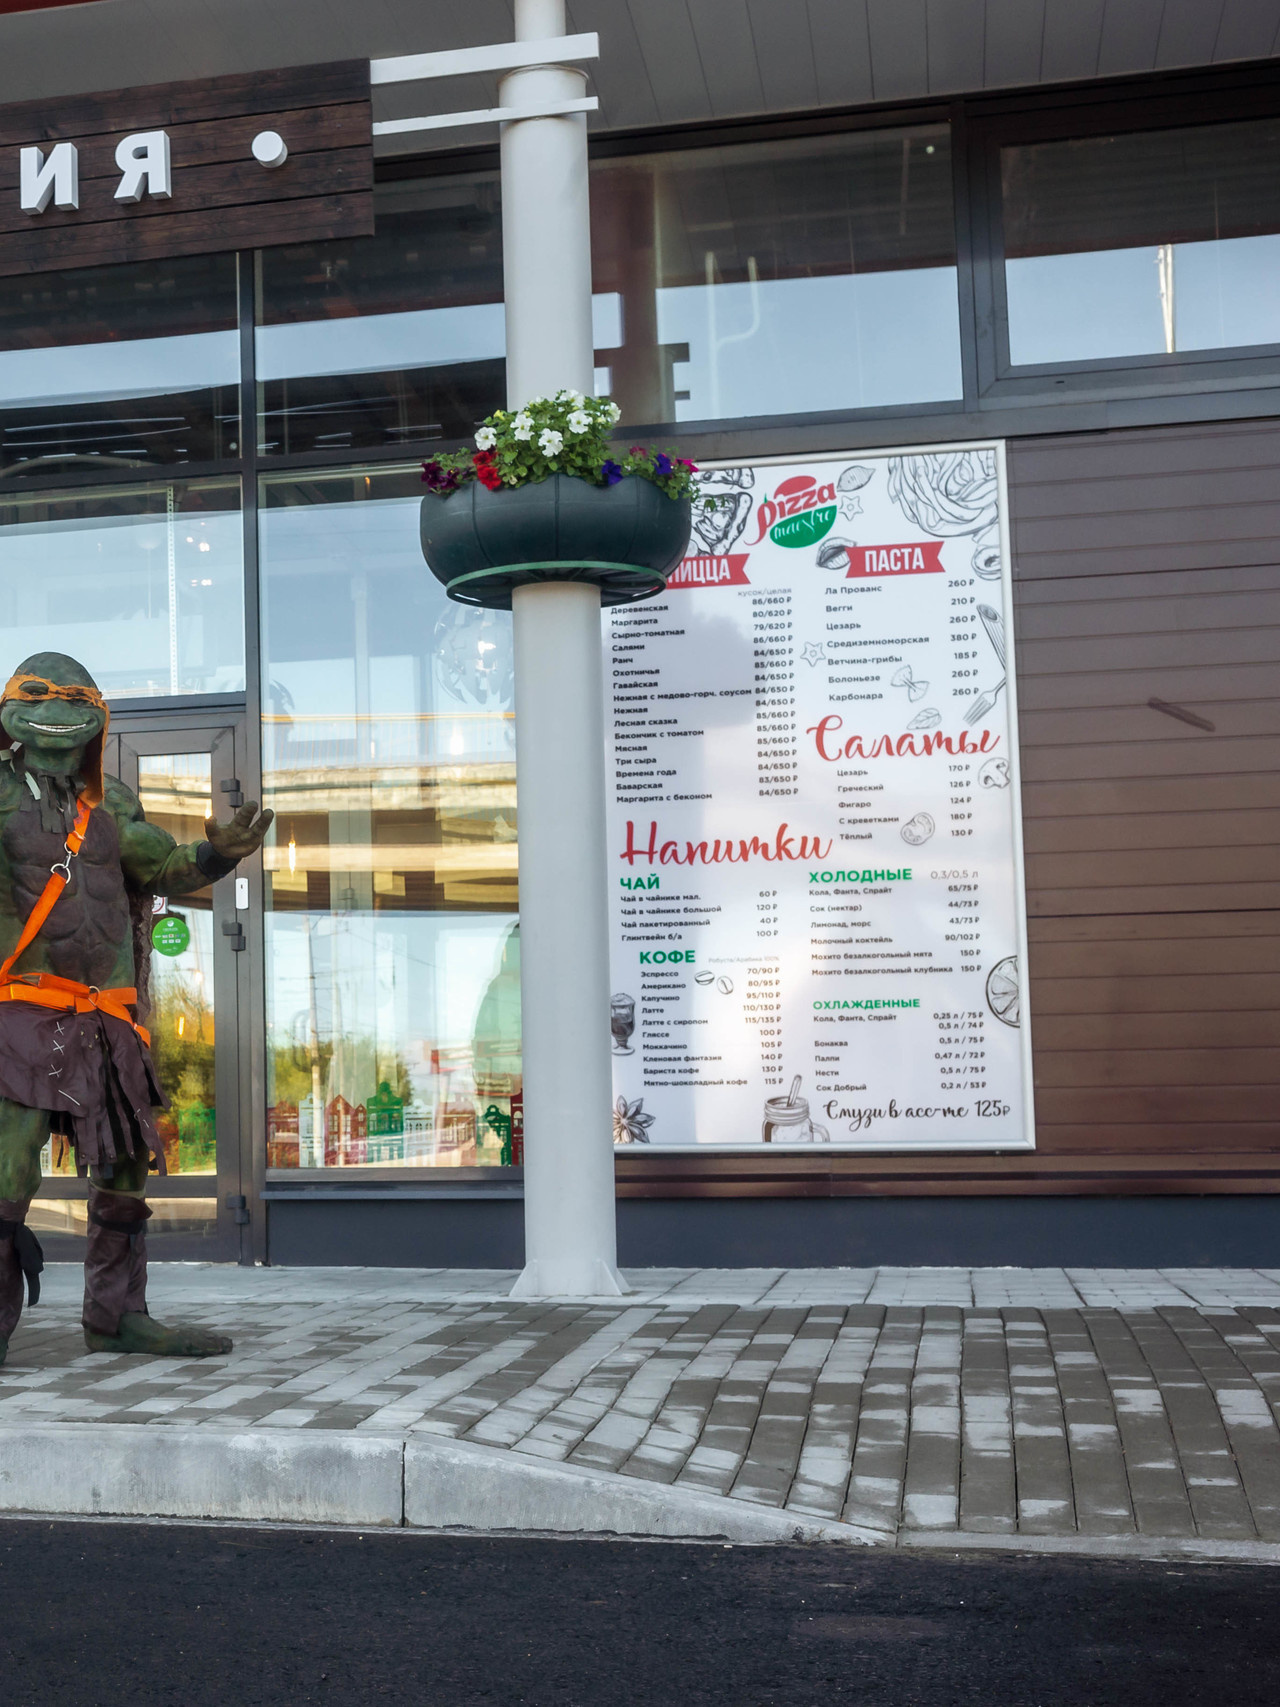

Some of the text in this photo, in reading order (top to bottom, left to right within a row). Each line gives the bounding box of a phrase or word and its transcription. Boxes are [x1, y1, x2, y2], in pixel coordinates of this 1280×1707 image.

[865, 548, 924, 572] ПАСТА
[825, 585, 882, 595] Ла Прованс
[611, 605, 668, 615] Деревенская
[753, 610, 785, 618] 80/620
[612, 618, 658, 627] Маргарита
[754, 623, 785, 631] 79/620
[827, 622, 861, 631] Цезарь
[612, 629, 685, 639] Сырно-томатная
[827, 636, 929, 648] Средиземноморская
[612, 644, 645, 652] Салями
[828, 656, 902, 666] Ветчина-грибы
[613, 668, 660, 677] Охотничья
[829, 675, 880, 683] Болоньезе
[613, 681, 658, 689] Гавайская
[658, 691, 717, 701] медово-горч.
[719, 689, 752, 697] соусом
[953, 688, 971, 696] 260
[829, 693, 883, 701] Карбонара
[667, 729, 704, 737] томатом
[806, 715, 1000, 761] Салаты
[616, 757, 656, 766] Три сыра
[616, 769, 676, 778] Времена года
[837, 769, 868, 777] Цезарь
[617, 782, 663, 791] Баварская
[838, 784, 884, 793] Греческий
[617, 795, 663, 804] Маргарита
[839, 801, 871, 809] Фигаро
[620, 821, 833, 866] Напитки
[809, 868, 912, 883] ХОЛОДНЫЕ
[620, 874, 660, 890] ЧАЙ
[834, 888, 861, 896] Фанта,
[863, 886, 892, 896] Спрайт
[621, 908, 636, 916] Чай
[683, 905, 721, 914] большой
[828, 904, 862, 912] (нектар)
[639, 919, 710, 928] пакетированный
[851, 920, 871, 928] морс
[622, 933, 665, 941] Глинтвейн
[811, 936, 893, 945] Молочный коктейль
[640, 950, 695, 964] КОФЕ
[844, 950, 911, 959] безалкогольный
[641, 970, 679, 978] Эспрессо
[812, 965, 953, 976] Мохито безалкогольный клубника
[641, 982, 686, 990] Американо
[642, 994, 680, 1003] Капучино
[743, 1004, 774, 1012] 110/130
[813, 999, 920, 1010] ОХЛАЖДЕННЫЕ
[674, 1018, 708, 1026] сиропом
[868, 1013, 897, 1022] Спрайт
[643, 1043, 687, 1051] Моккачино
[643, 1054, 722, 1063] Кленовая фантазия
[643, 1067, 699, 1075] Бариста кофе
[644, 1078, 747, 1087] Мятно-шоколадный кофе
[834, 1083, 866, 1092] Добрый
[823, 1100, 886, 1132] Смузи
